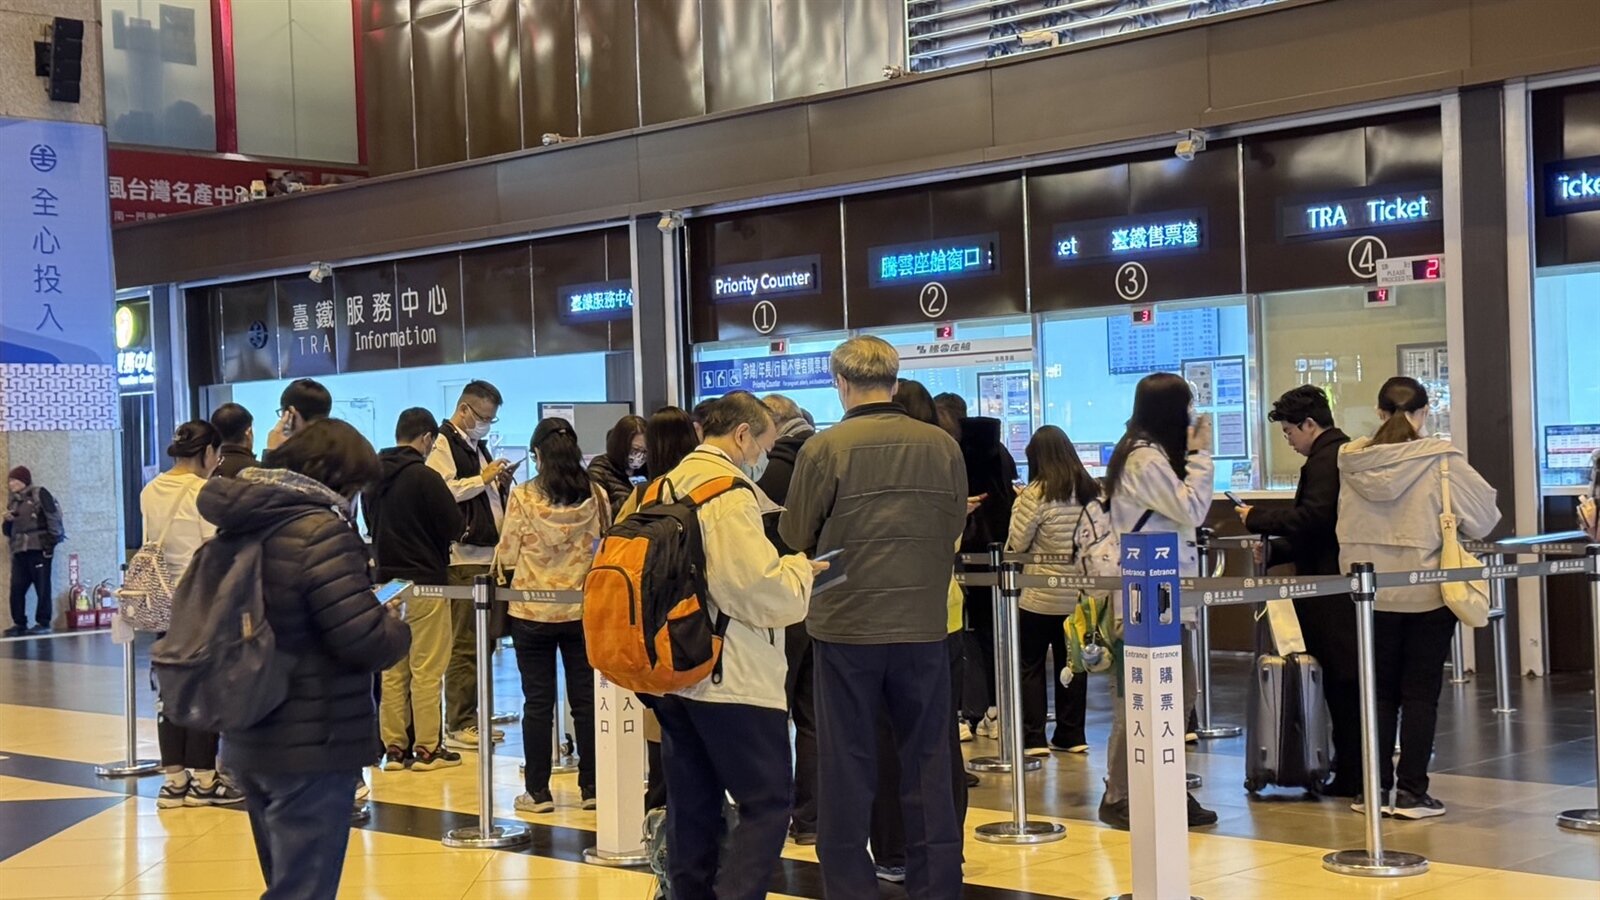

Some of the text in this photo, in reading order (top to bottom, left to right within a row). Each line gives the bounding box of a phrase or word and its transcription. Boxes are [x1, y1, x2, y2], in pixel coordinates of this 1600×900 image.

[109, 176, 248, 206] 風台灣名產中
[1558, 172, 1600, 198] icke
[1307, 195, 1429, 229] TRA Ticket
[32, 186, 64, 333] 全心投入
[1426, 259, 1439, 278] 2
[715, 272, 811, 295] Priority Counter
[1378, 290, 1386, 301] 4
[299, 326, 437, 356] TRA Information
[1122, 568, 1146, 577] Entrance
[1149, 568, 1176, 577] Entrance
[1125, 650, 1148, 659] Entrance
[1152, 651, 1179, 659] Entrance
[623, 697, 634, 734] 入口
[1131, 666, 1145, 765] 購票入口
[1160, 666, 1175, 765] 購票入口
